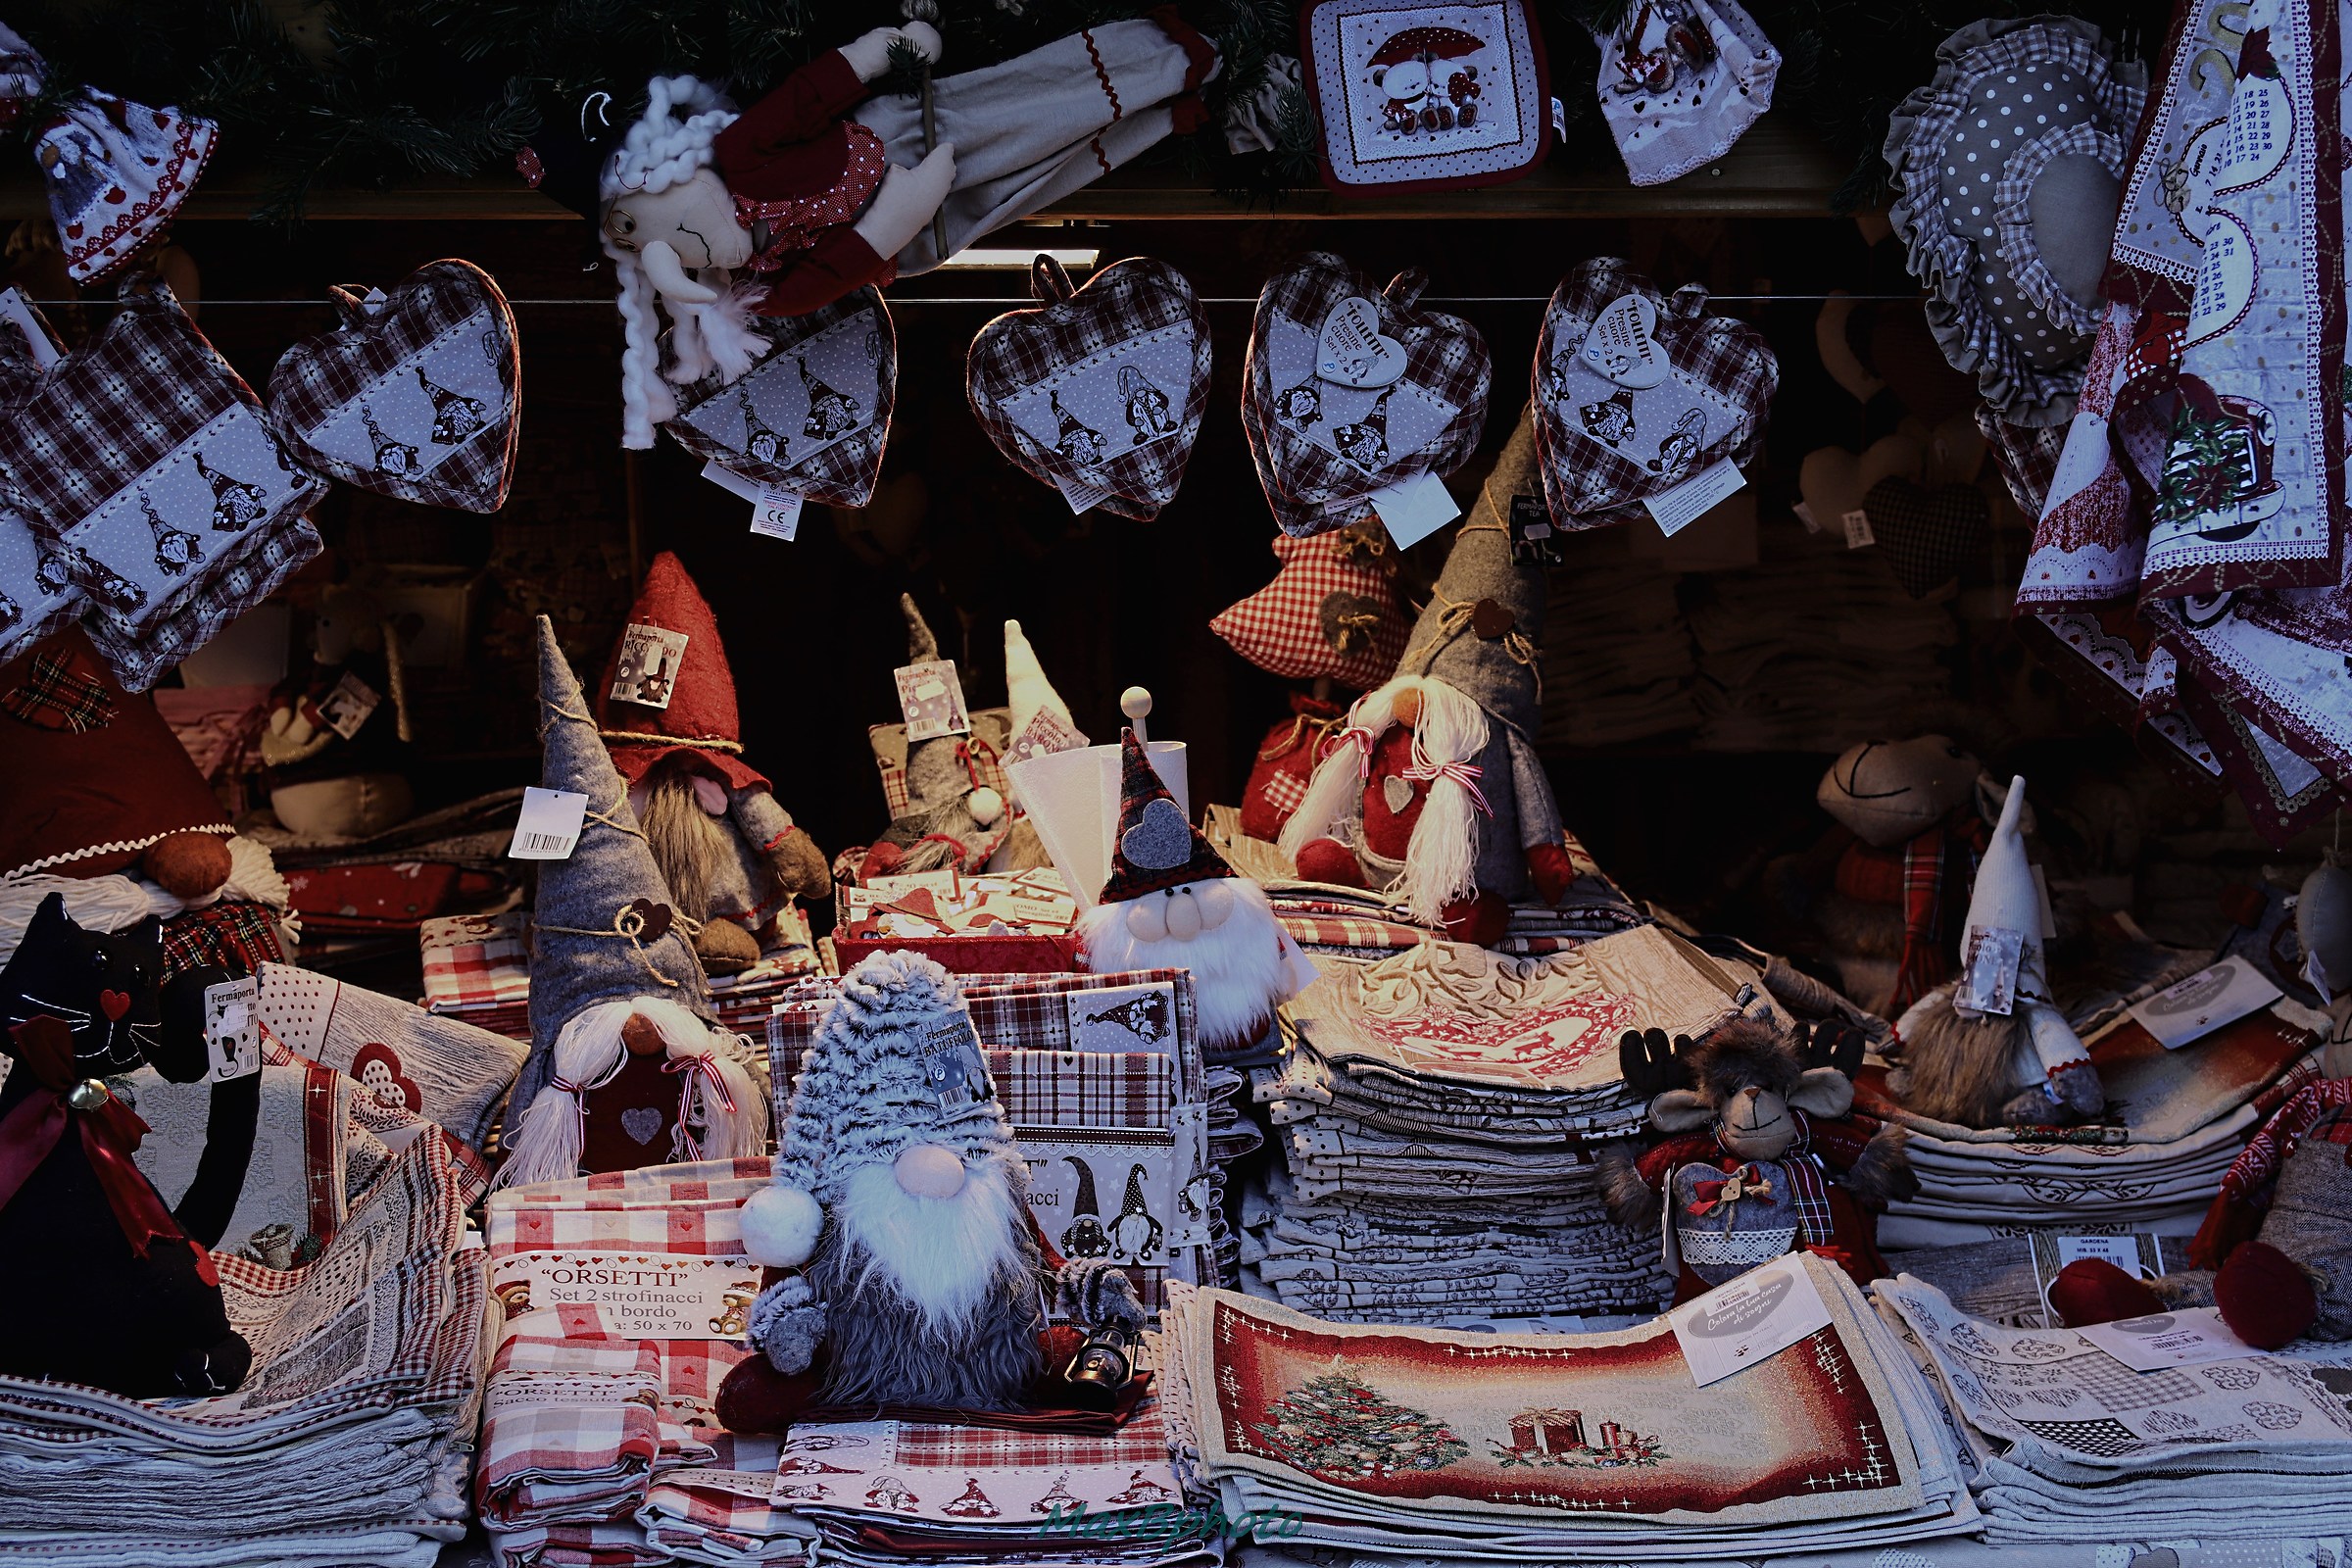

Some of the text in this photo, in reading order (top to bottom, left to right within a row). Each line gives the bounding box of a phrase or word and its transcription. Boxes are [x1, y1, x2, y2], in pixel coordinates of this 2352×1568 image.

[2245, 100, 2255, 109] 19
[2234, 134, 2243, 143] 15
[2235, 144, 2244, 153] 16
[2189, 144, 2207, 176] Gennaio
[2236, 154, 2246, 163] 17
[2209, 166, 2218, 176] 14
[2223, 237, 2233, 246] 30
[2211, 262, 2220, 270] 25
[2214, 281, 2223, 291] 27
[1335, 316, 1362, 351] Presine
[1597, 325, 1607, 340] Set
[1607, 316, 1621, 345] cuore
[1615, 308, 1631, 347] Presine
[1325, 335, 1337, 351] Set
[1331, 325, 1352, 351] cuore
[767, 510, 786, 524] CE
[625, 640, 677, 657] RICCDO
[1031, 717, 1060, 743] Piccolo
[212, 988, 255, 1004] Fermaporta
[926, 1021, 966, 1041] Fermaporta
[923, 1029, 974, 1057] BATUFFOLO
[550, 1288, 703, 1304] Set 2 strofinacci
[621, 1304, 676, 1318] bordo
[1707, 1308, 1736, 1331] Colora
[1736, 1304, 1744, 1313] la
[1761, 1283, 1782, 1298] casa
[1734, 1298, 1772, 1325] di sogni
[633, 1321, 653, 1331] 50
[673, 1321, 692, 1331] 70
[493, 1397, 547, 1408] Sacco
